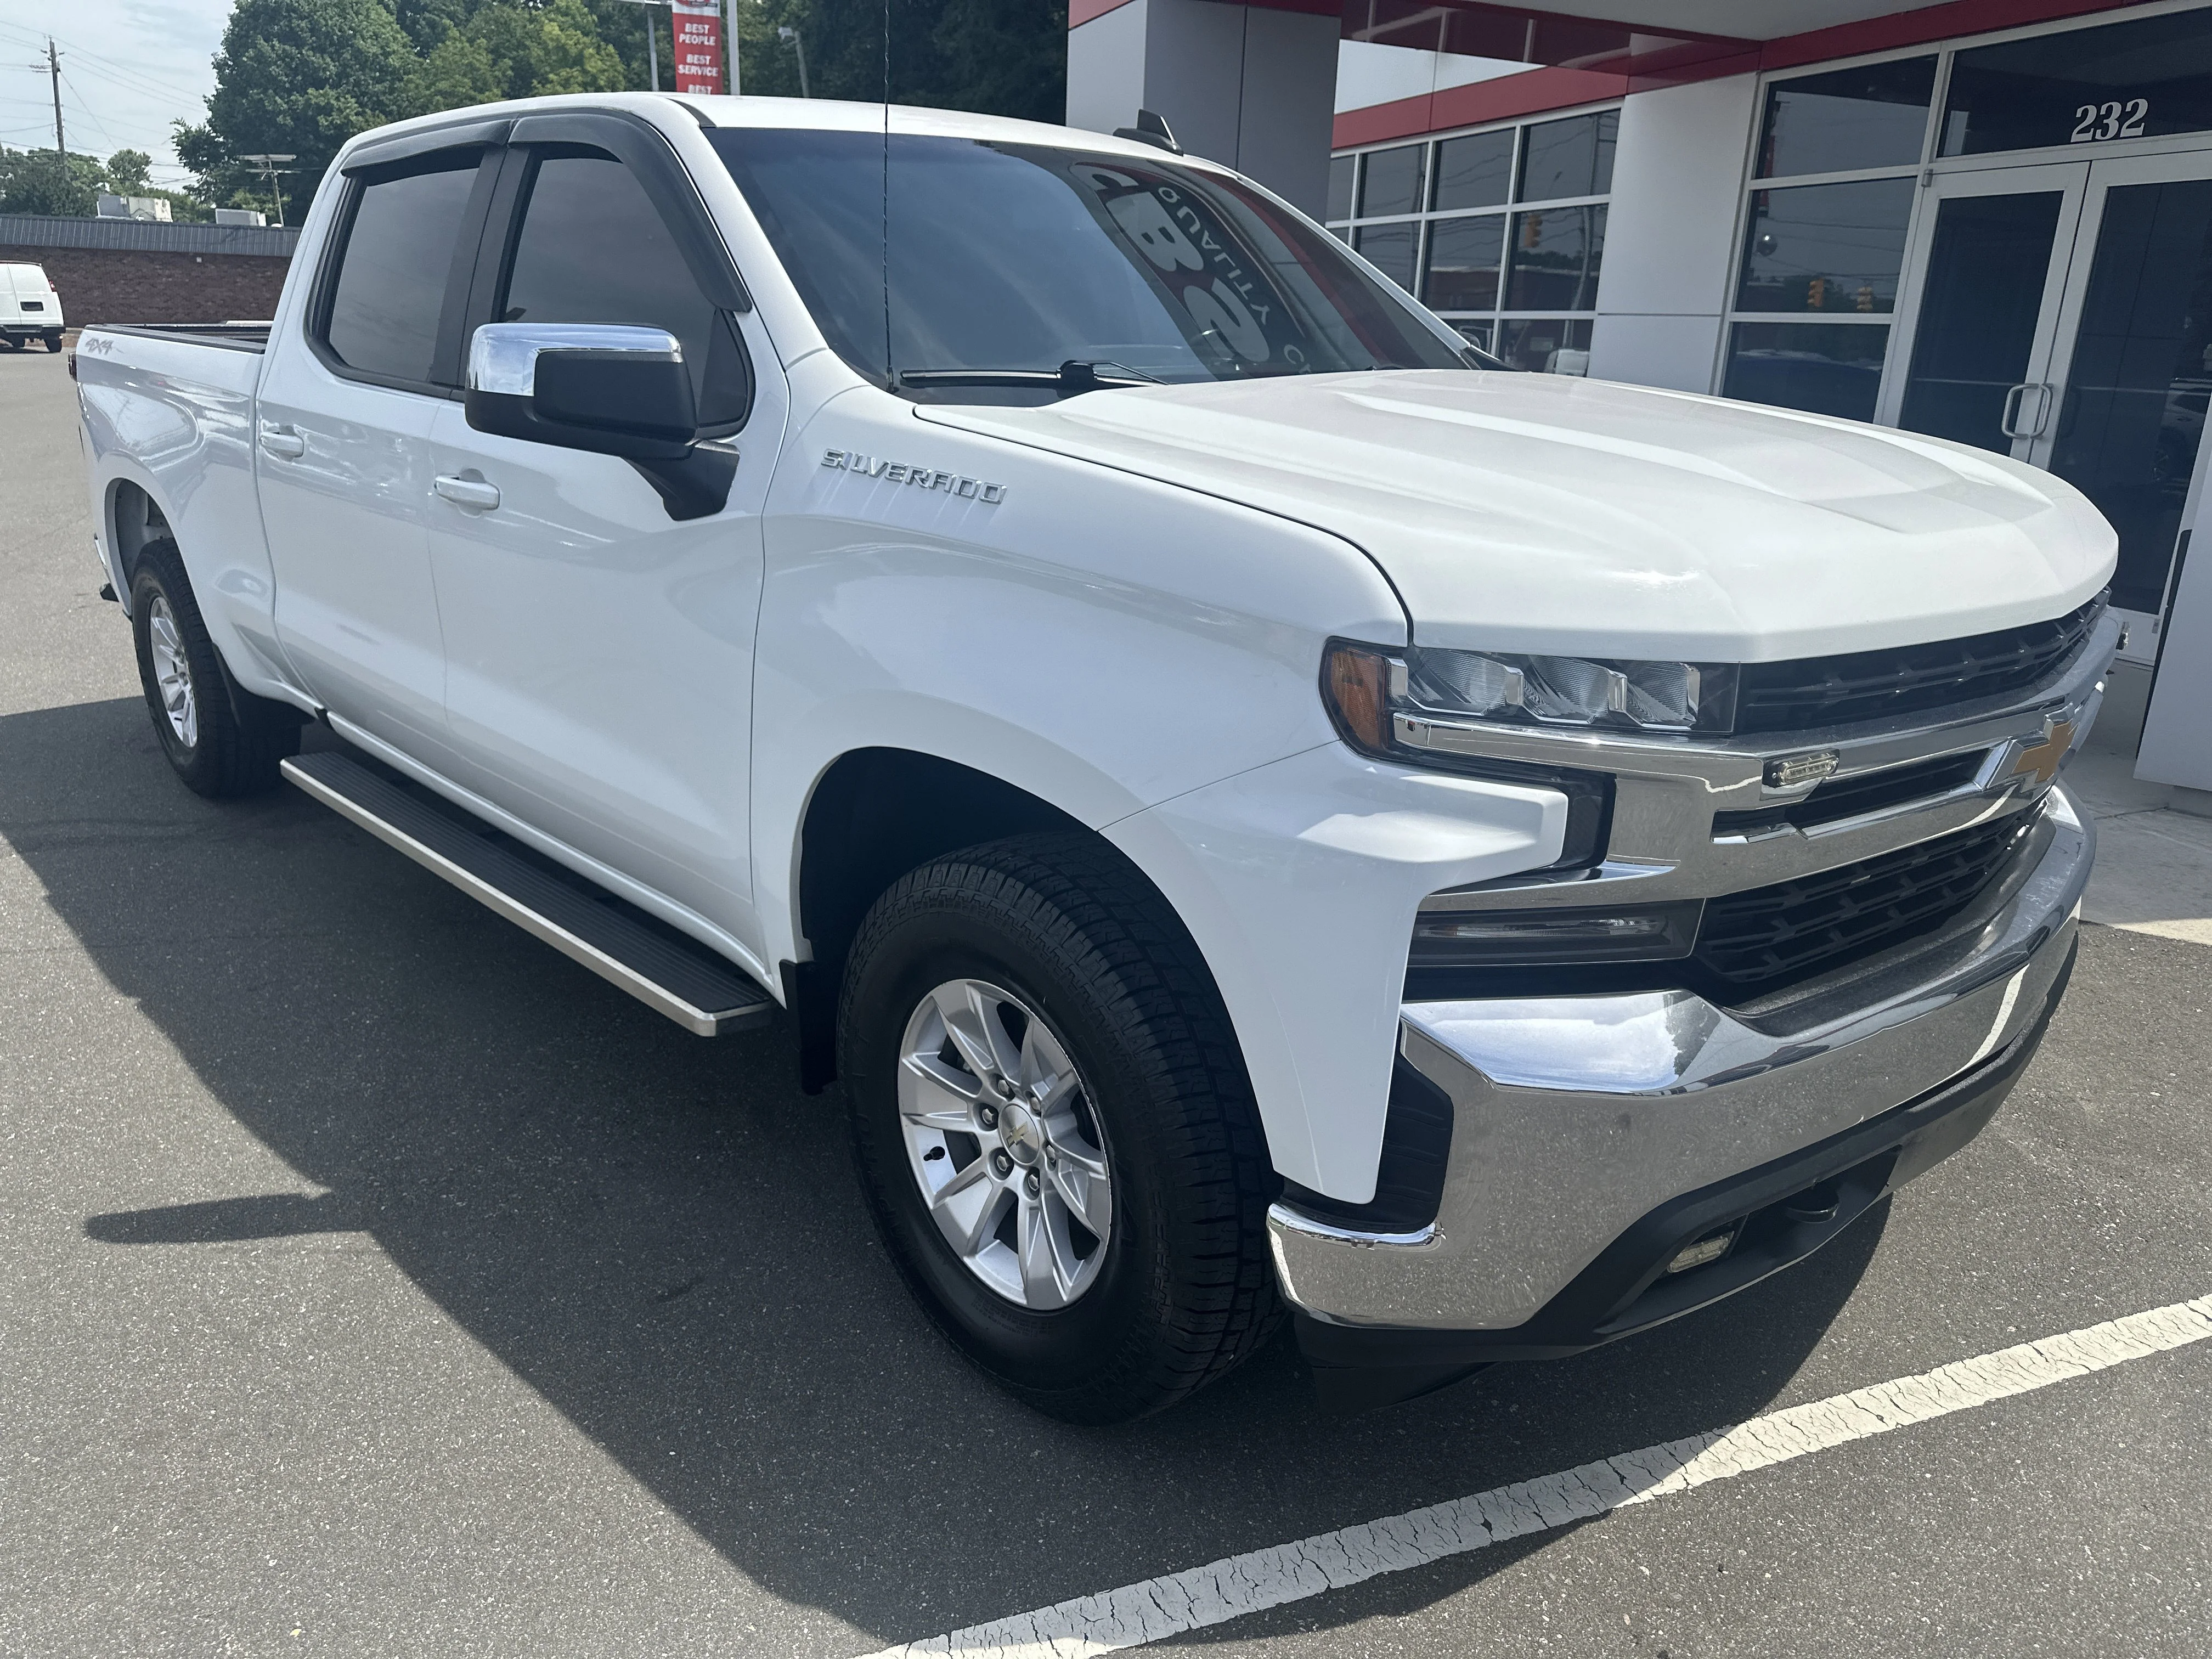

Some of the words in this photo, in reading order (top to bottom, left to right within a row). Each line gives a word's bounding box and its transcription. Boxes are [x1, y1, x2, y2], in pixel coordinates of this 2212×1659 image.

[685, 23, 710, 33] BEST
[679, 33, 716, 46] PEOPLE
[686, 54, 711, 65] BEST
[678, 65, 718, 77] SERVICE
[688, 84, 713, 94] BEST
[2070, 98, 2148, 143] 232
[821, 448, 1008, 505] SILVERADO
